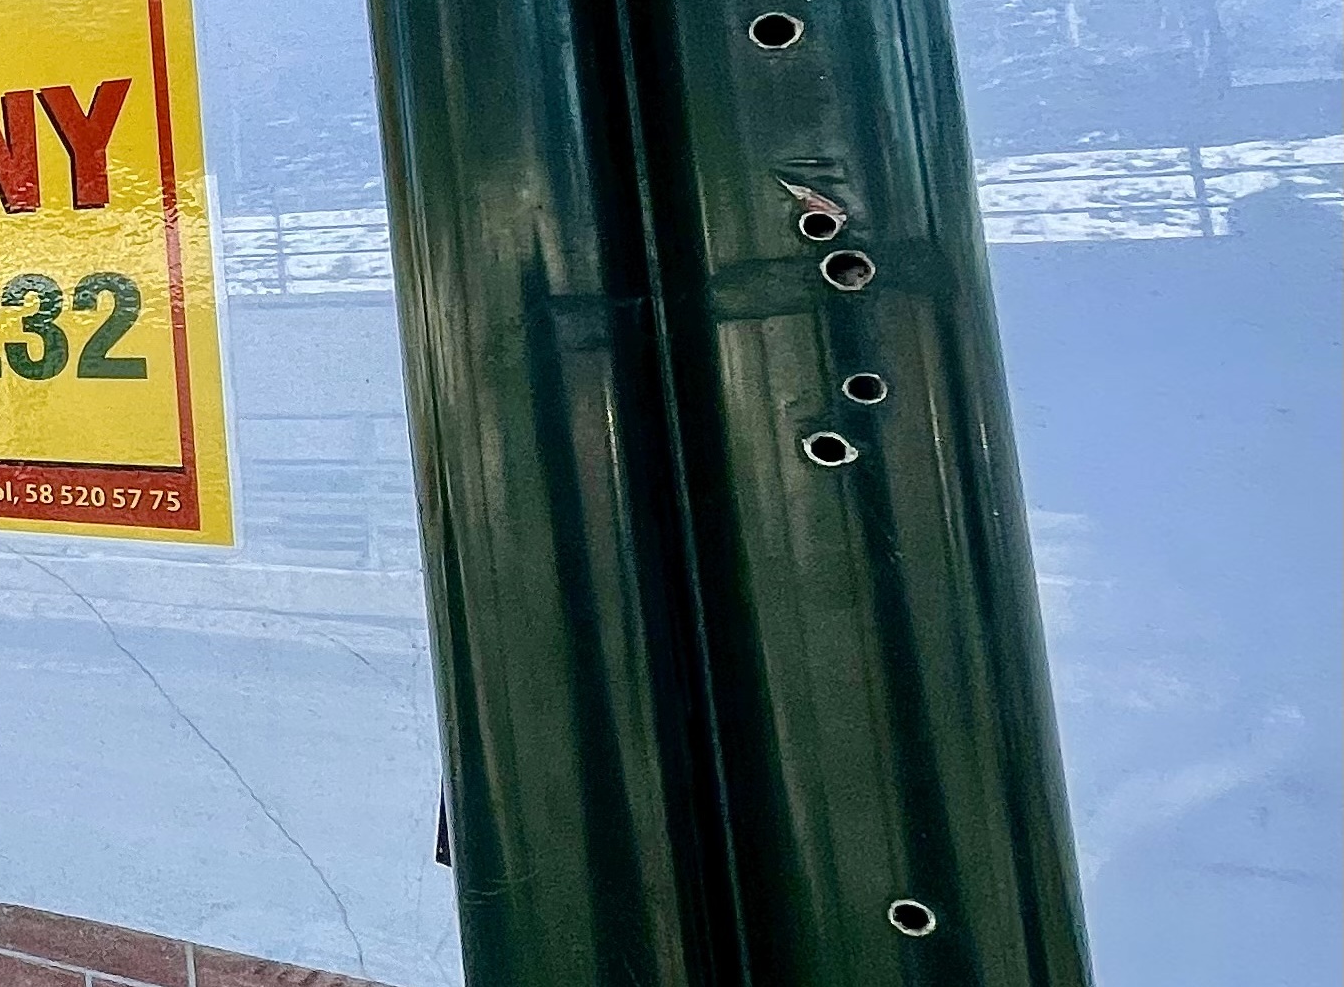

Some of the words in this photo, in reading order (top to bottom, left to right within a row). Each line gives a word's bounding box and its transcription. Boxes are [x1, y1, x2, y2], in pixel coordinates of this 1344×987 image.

[25, 485, 54, 504] 58
[60, 486, 105, 507] 520
[112, 488, 141, 509] 57
[150, 490, 181, 511] 75
